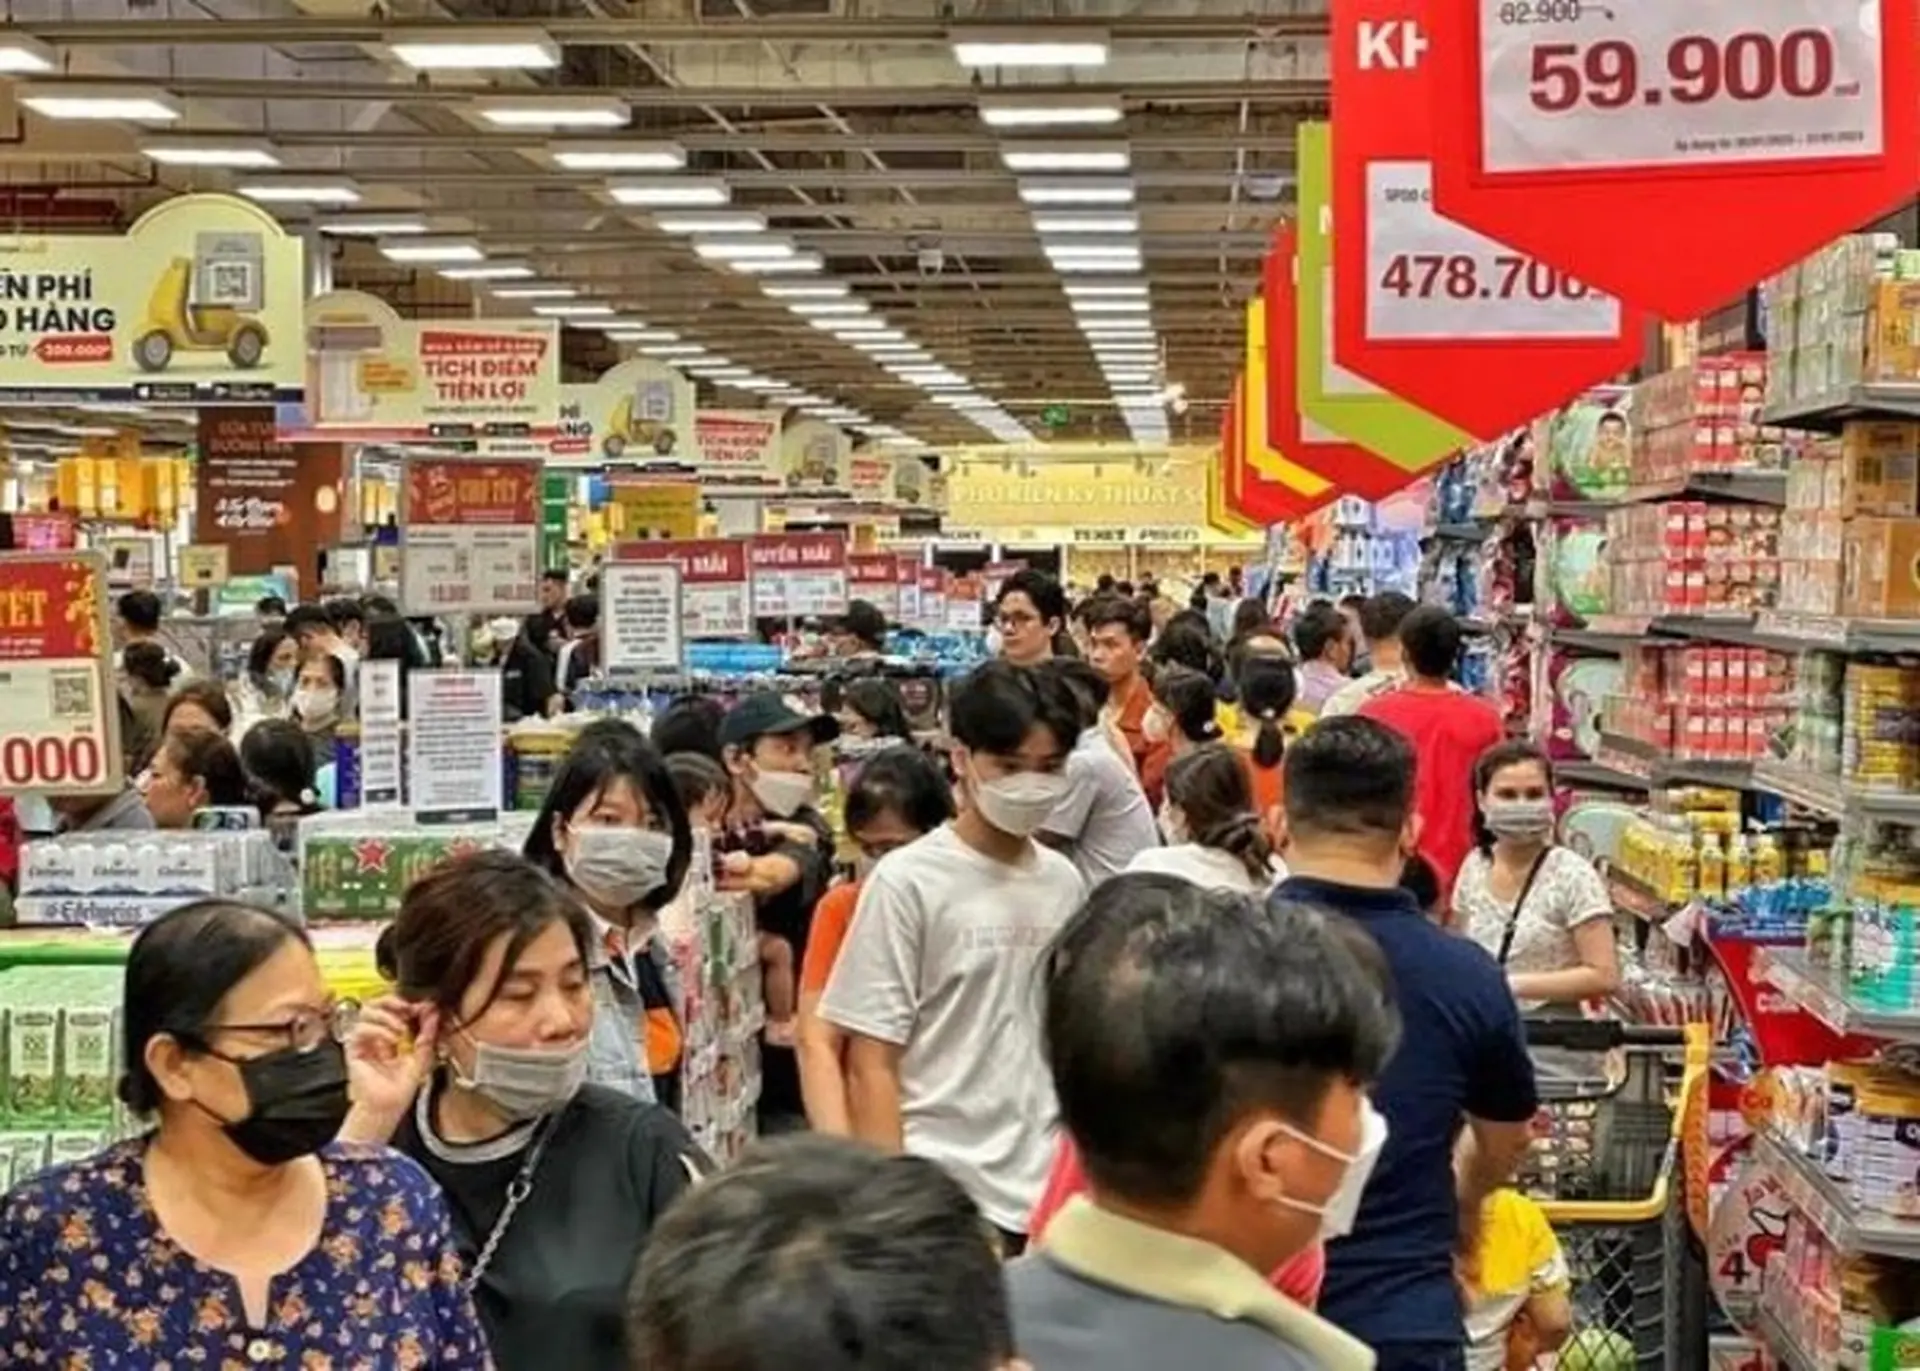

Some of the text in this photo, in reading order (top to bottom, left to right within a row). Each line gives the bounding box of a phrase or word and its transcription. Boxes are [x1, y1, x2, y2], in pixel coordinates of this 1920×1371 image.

[1530, 29, 1834, 112] 59.900
[38, 267, 92, 300] PHÍ
[16, 301, 116, 333] HÀNG
[423, 358, 476, 376] TÍCH
[1719, 1250, 1752, 1285] 4
